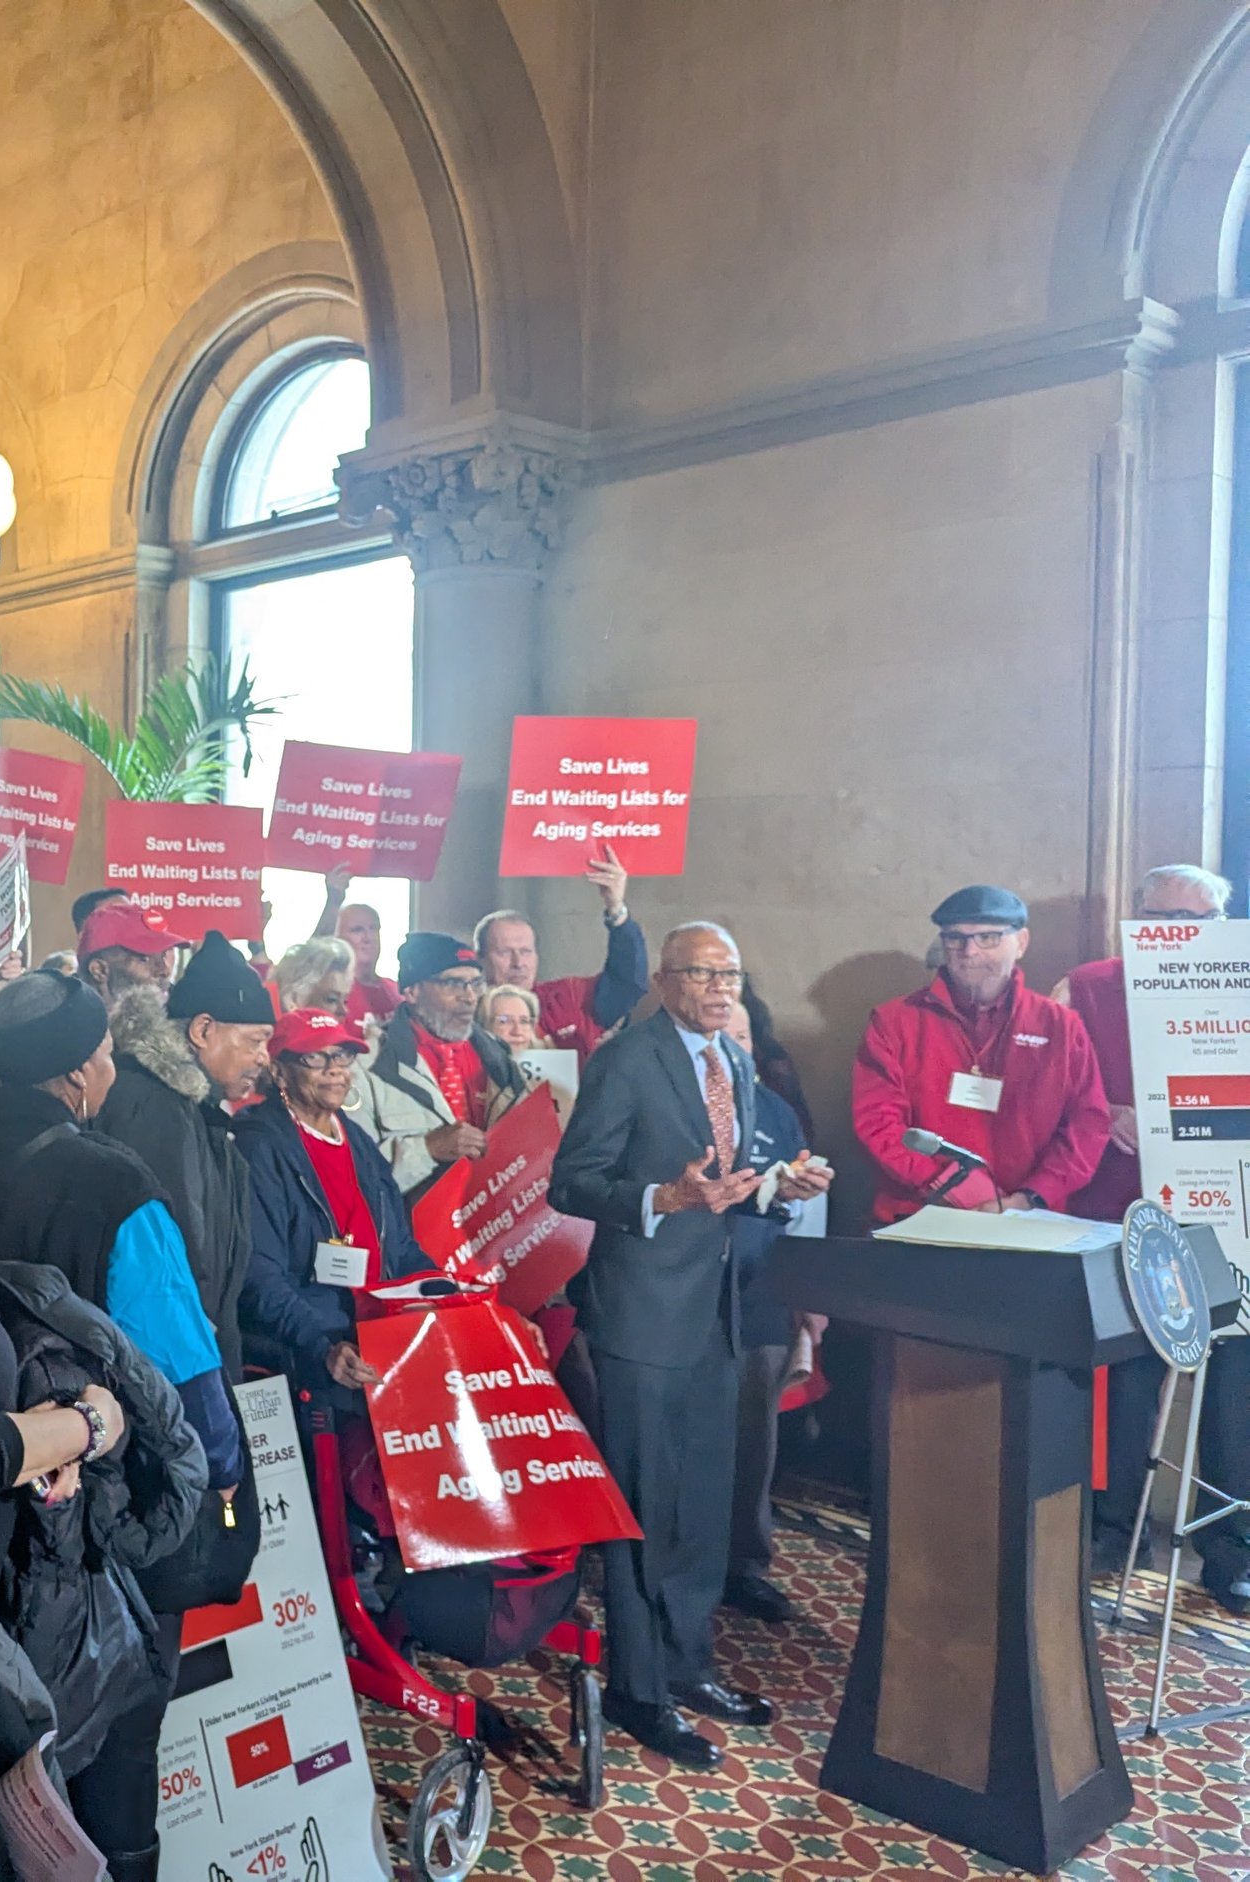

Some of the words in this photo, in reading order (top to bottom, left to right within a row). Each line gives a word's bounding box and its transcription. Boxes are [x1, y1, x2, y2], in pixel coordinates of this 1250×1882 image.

[559, 757, 603, 775] Save
[607, 758, 649, 775] Lives
[30, 785, 58, 803] Lives
[321, 777, 364, 795] Save
[368, 781, 412, 800] Lives
[511, 789, 547, 806] End
[552, 790, 617, 811] Waiting
[621, 790, 658, 806] Lists
[662, 790, 688, 806] for
[38, 814, 64, 830] Lists
[63, 818, 77, 832] for
[275, 798, 308, 815] End
[312, 802, 376, 826] Waiting
[380, 810, 421, 827] Lists
[423, 813, 447, 829] for
[292, 827, 343, 850] Aging
[346, 834, 417, 852] Services
[533, 820, 587, 841] Aging
[591, 820, 661, 838] Services
[25, 835, 59, 853] ervices
[146, 836, 183, 852] Save
[186, 838, 225, 853] Lives
[108, 864, 138, 879] End
[141, 864, 198, 883] Waiting
[202, 866, 238, 881] Lists
[241, 867, 261, 881] for
[129, 892, 174, 909] Aging
[177, 893, 242, 909] Services
[1130, 925, 1200, 941] AARP
[1136, 943, 1158, 951] New
[1160, 942, 1182, 951] York
[1159, 963, 1190, 974] NEW
[1133, 978, 1220, 990] POPULATION
[1224, 978, 1250, 989] AND
[1166, 1020, 1192, 1034] 3.5
[1175, 1095, 1198, 1105] 3.56
[1200, 1095, 1210, 1105] M
[1178, 1127, 1201, 1137] 2.51
[1201, 1126, 1212, 1136] M
[451, 1190, 488, 1229] Save
[487, 1155, 527, 1196] Lives
[1188, 1190, 1231, 1207] 50%
[455, 1209, 514, 1265] Waiting
[511, 1177, 549, 1214] Lists
[1133, 1208, 1160, 1229] YORK
[1171, 1336, 1203, 1363] SENATE
[444, 1368, 512, 1395] Save
[244, 1407, 278, 1422] Future
[251, 1433, 269, 1448] ER
[382, 1424, 443, 1455] End
[252, 1445, 297, 1468] CREASE
[437, 1468, 522, 1501] Agg
[526, 1455, 606, 1485] Services
[272, 1592, 317, 1628] 30%
[222, 1709, 236, 1721] New
[237, 1700, 261, 1715] Yorkers
[260, 1692, 279, 1705] Living
[297, 1676, 319, 1690] Poverty
[402, 1687, 440, 1717] F-22
[161, 1764, 201, 1801] 50%
[230, 1848, 244, 1858] New
[244, 1841, 259, 1851] York
[246, 1842, 287, 1876] <1%
